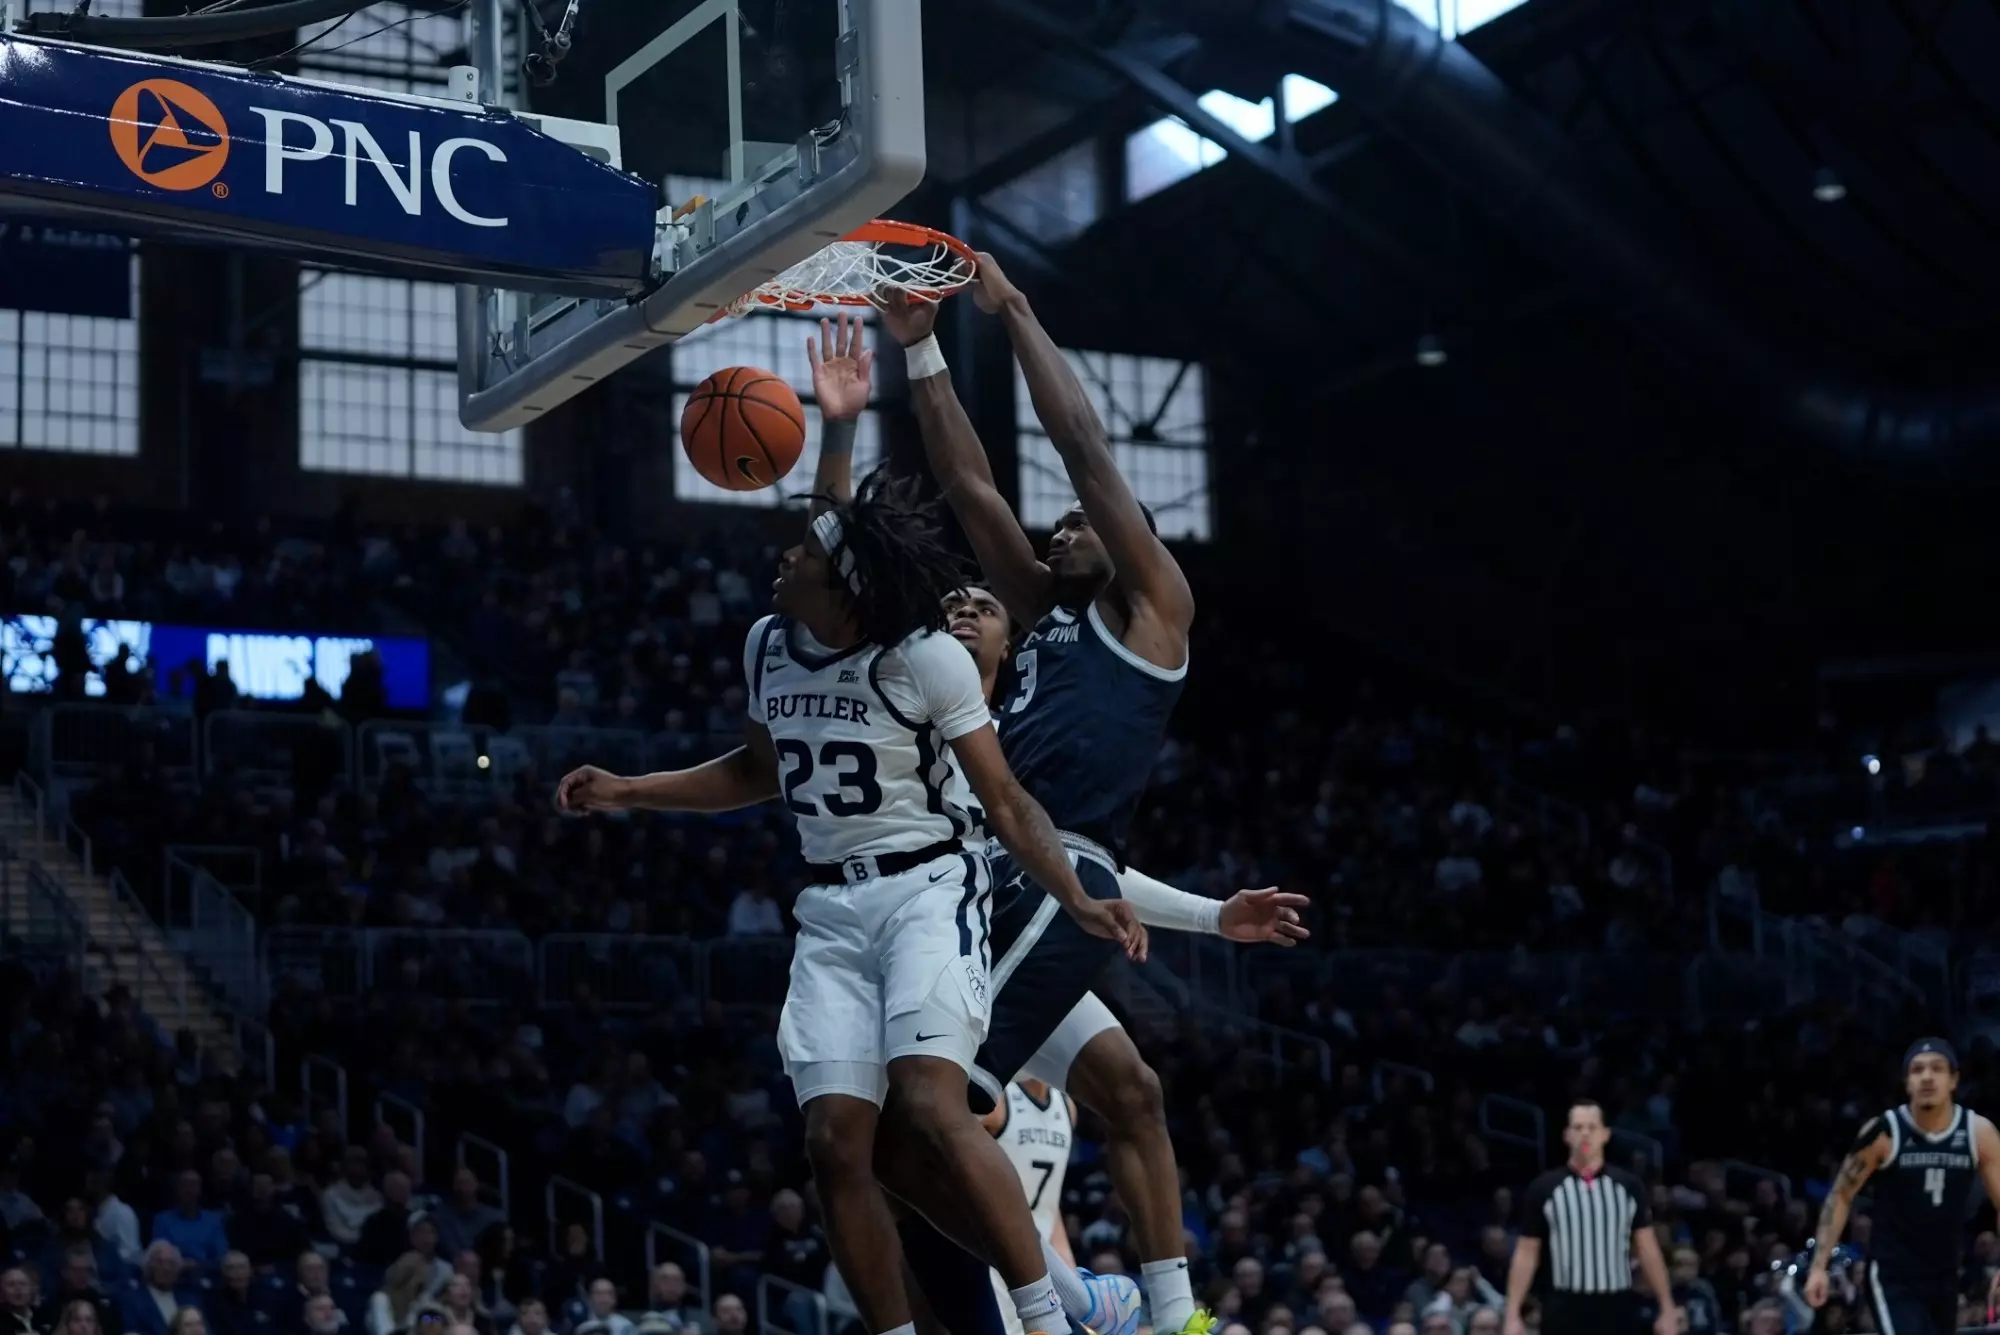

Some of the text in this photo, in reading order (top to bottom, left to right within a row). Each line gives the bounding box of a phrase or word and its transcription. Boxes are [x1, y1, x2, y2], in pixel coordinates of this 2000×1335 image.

[249, 106, 509, 227] PNC
[1009, 648, 1038, 714] 3
[767, 694, 871, 726] BUTLER
[775, 739, 882, 817] 23
[852, 862, 868, 881] B
[1018, 1127, 1068, 1149] BUTLER
[1031, 1160, 1055, 1210] 7
[1923, 1168, 1946, 1207] 4
